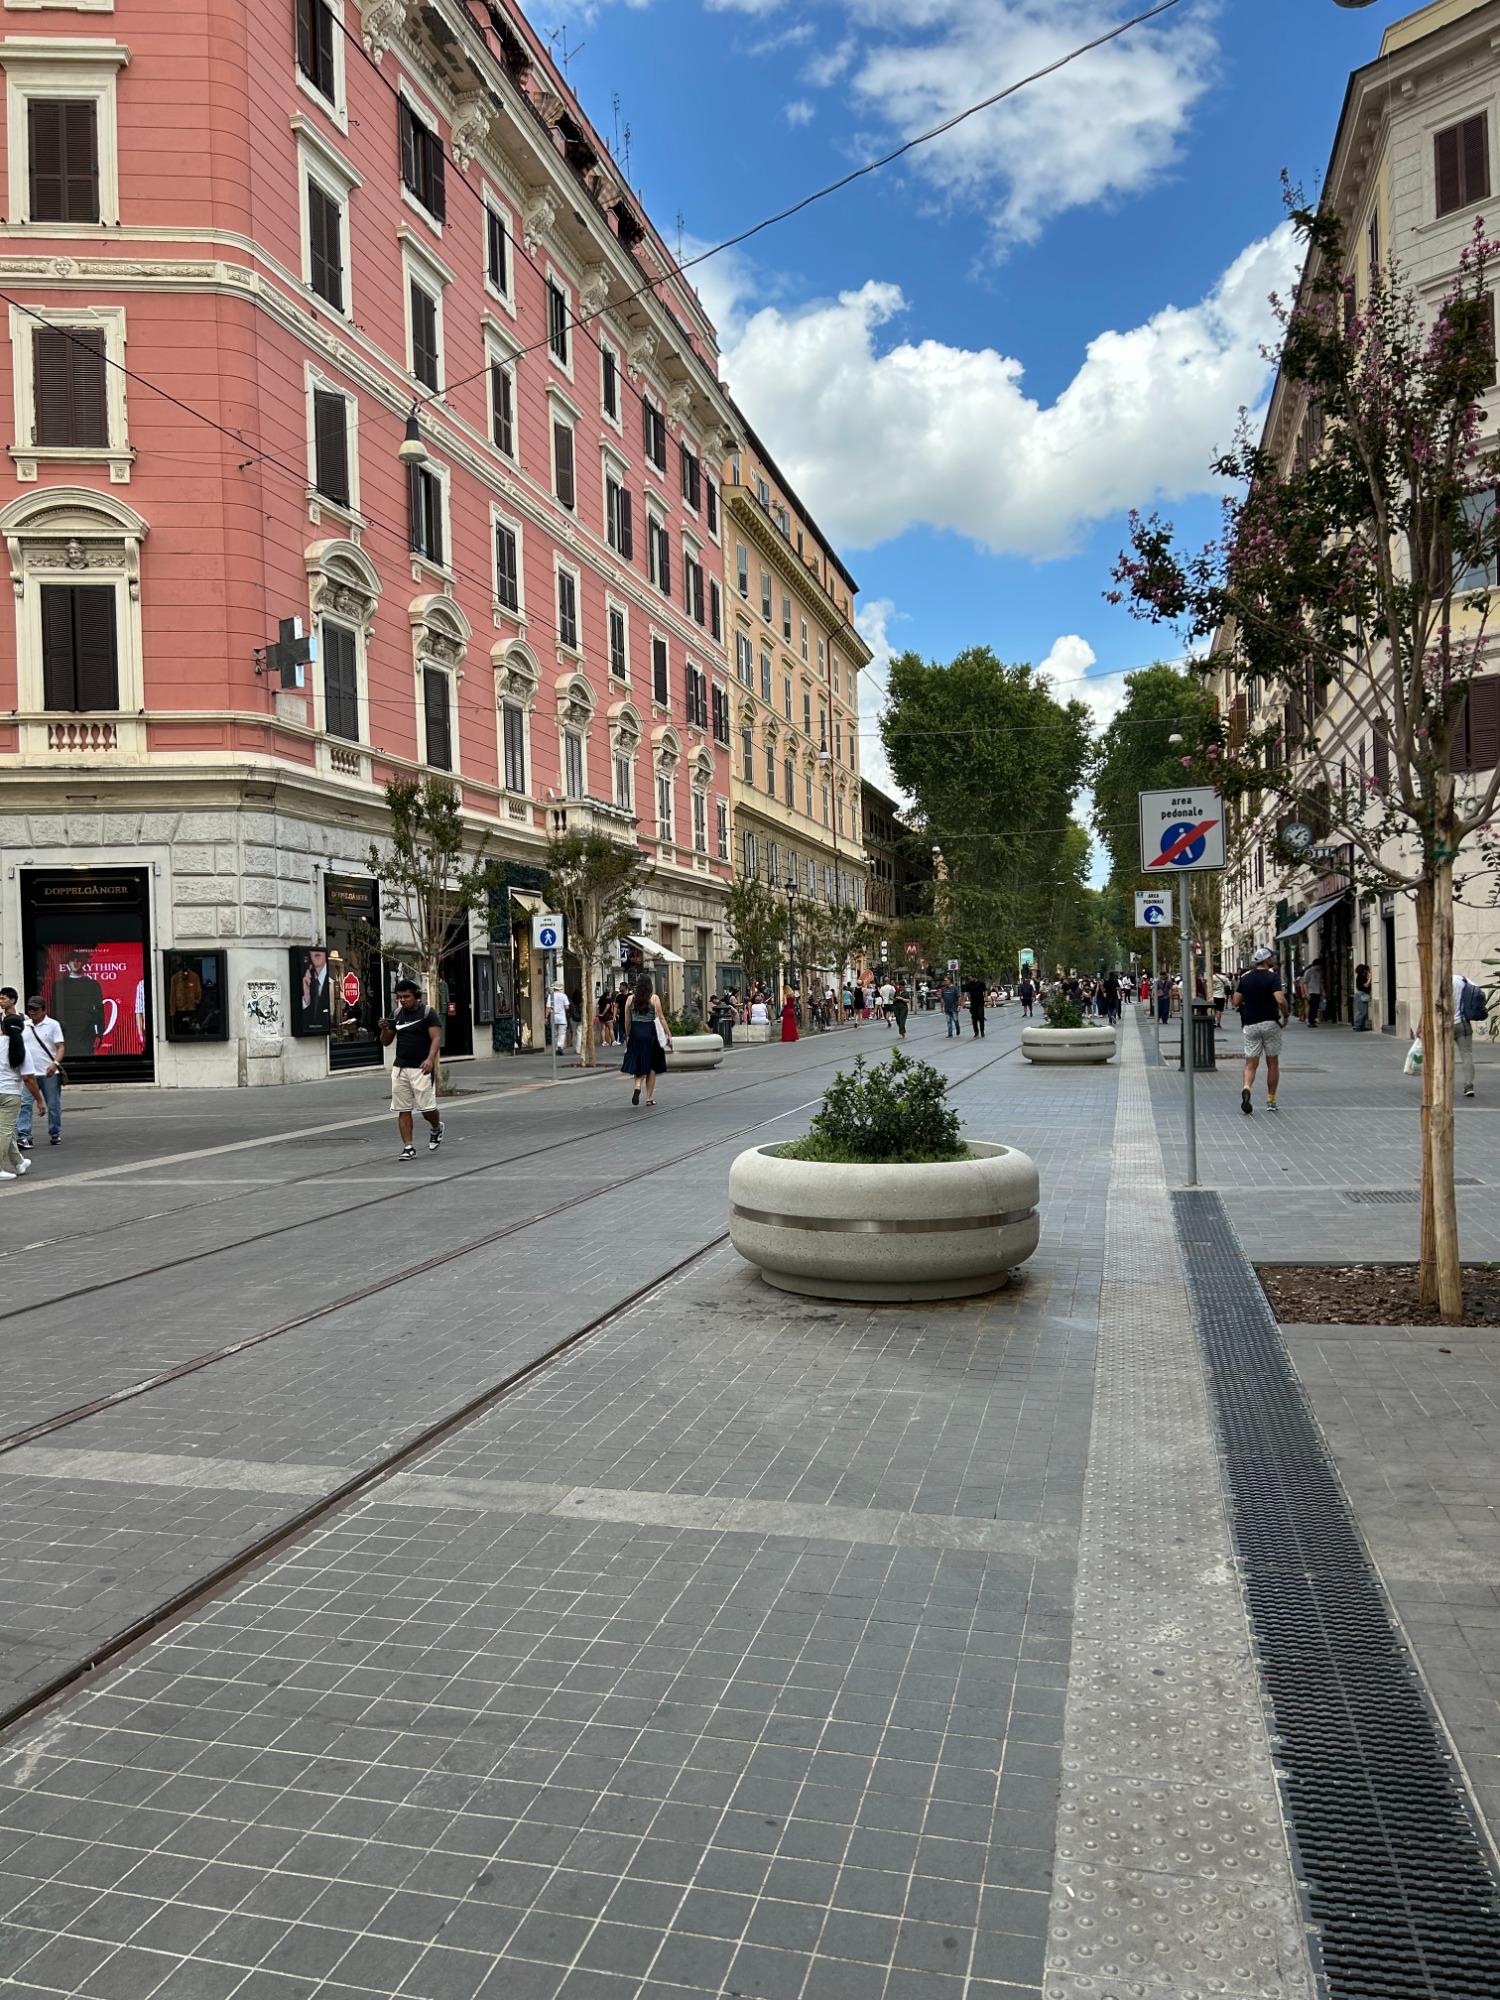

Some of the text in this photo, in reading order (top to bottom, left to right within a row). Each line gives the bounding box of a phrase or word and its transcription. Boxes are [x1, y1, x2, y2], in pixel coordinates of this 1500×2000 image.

[1171, 797, 1193, 806] area
[1161, 807, 1204, 820] pedonale
[101, 972, 117, 980] GO
